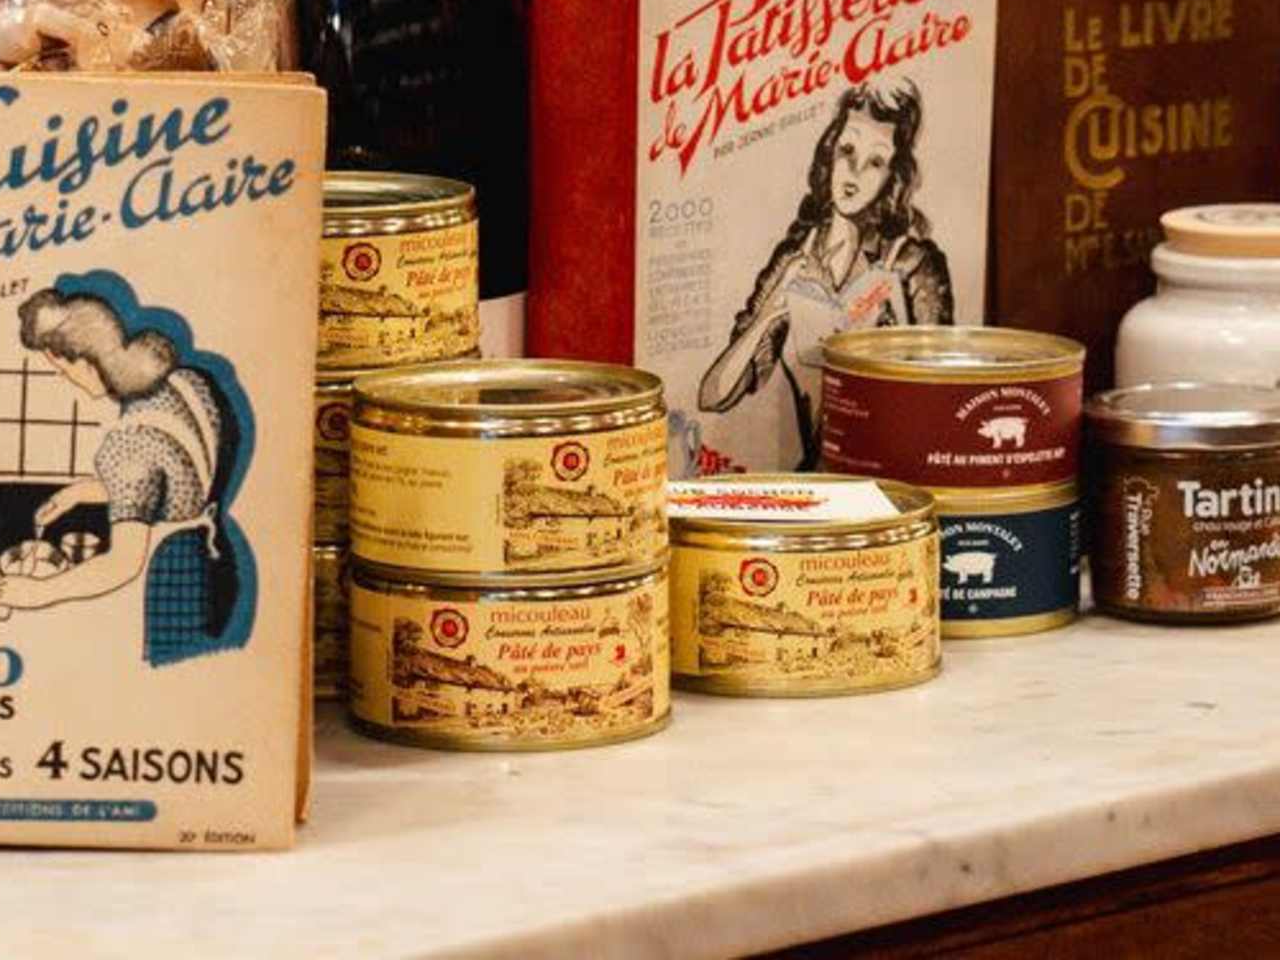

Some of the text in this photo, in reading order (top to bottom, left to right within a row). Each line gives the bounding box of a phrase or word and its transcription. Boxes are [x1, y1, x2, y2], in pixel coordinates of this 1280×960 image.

[649, 29, 699, 103] la
[1064, 51, 1109, 99] DE
[648, 100, 689, 162] de
[648, 197, 715, 224] 2000
[1064, 193, 1109, 234] DE
[954, 388, 999, 421] MAISON
[926, 451, 952, 467] PÂTÉ
[968, 453, 1005, 466] PIMENT
[800, 549, 890, 572] micouleau
[805, 588, 842, 607] Pâté
[846, 587, 866, 603] de
[951, 588, 966, 600] DE
[490, 605, 592, 624] micouleau
[498, 643, 539, 661] Pâté
[542, 642, 562, 659] de
[35, 740, 69, 780] 4
[79, 745, 245, 786] SAISONS
